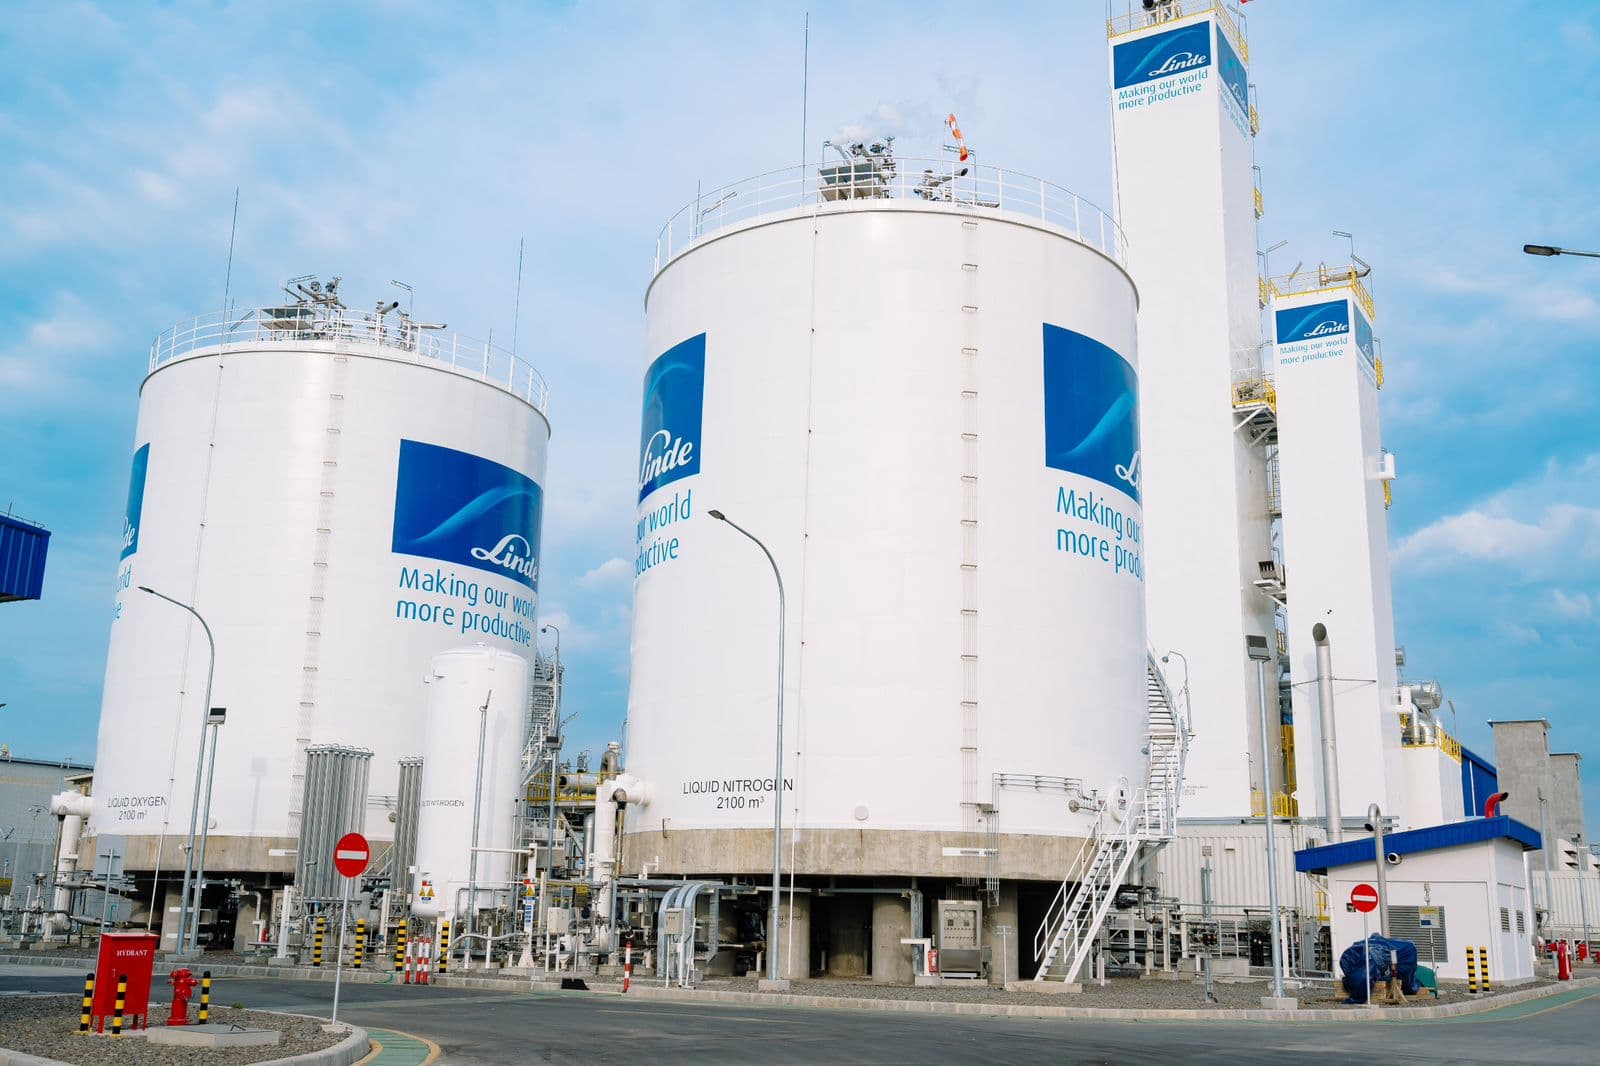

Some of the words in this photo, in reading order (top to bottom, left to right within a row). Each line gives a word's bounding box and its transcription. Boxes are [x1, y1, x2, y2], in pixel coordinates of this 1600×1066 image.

[1148, 51, 1207, 76] Linde
[1118, 84, 1156, 101] Making
[1159, 78, 1176, 90] our
[1179, 68, 1208, 84] world
[1118, 97, 1144, 111] more
[1147, 83, 1202, 105] productive
[1303, 320, 1349, 337] Linde
[1280, 343, 1308, 355] Making
[1310, 341, 1323, 350] our
[1325, 336, 1348, 347] world
[1280, 355, 1300, 365] more
[1302, 348, 1344, 363] productive
[649, 489, 692, 532] world
[1057, 486, 1123, 541] Making
[470, 533, 538, 582] Linde
[635, 537, 679, 579] ductive
[1057, 528, 1110, 562] more
[399, 567, 478, 607] Making
[484, 587, 509, 609] our
[396, 600, 455, 625] more
[461, 611, 531, 647] productive
[683, 780, 720, 794] LIQUID
[107, 797, 130, 808] LIQUID
[131, 796, 167, 807] OXYGEN
[118, 810, 136, 820] 2100
[716, 796, 745, 809] 2100
[116, 949, 148, 957] HYDRANT
